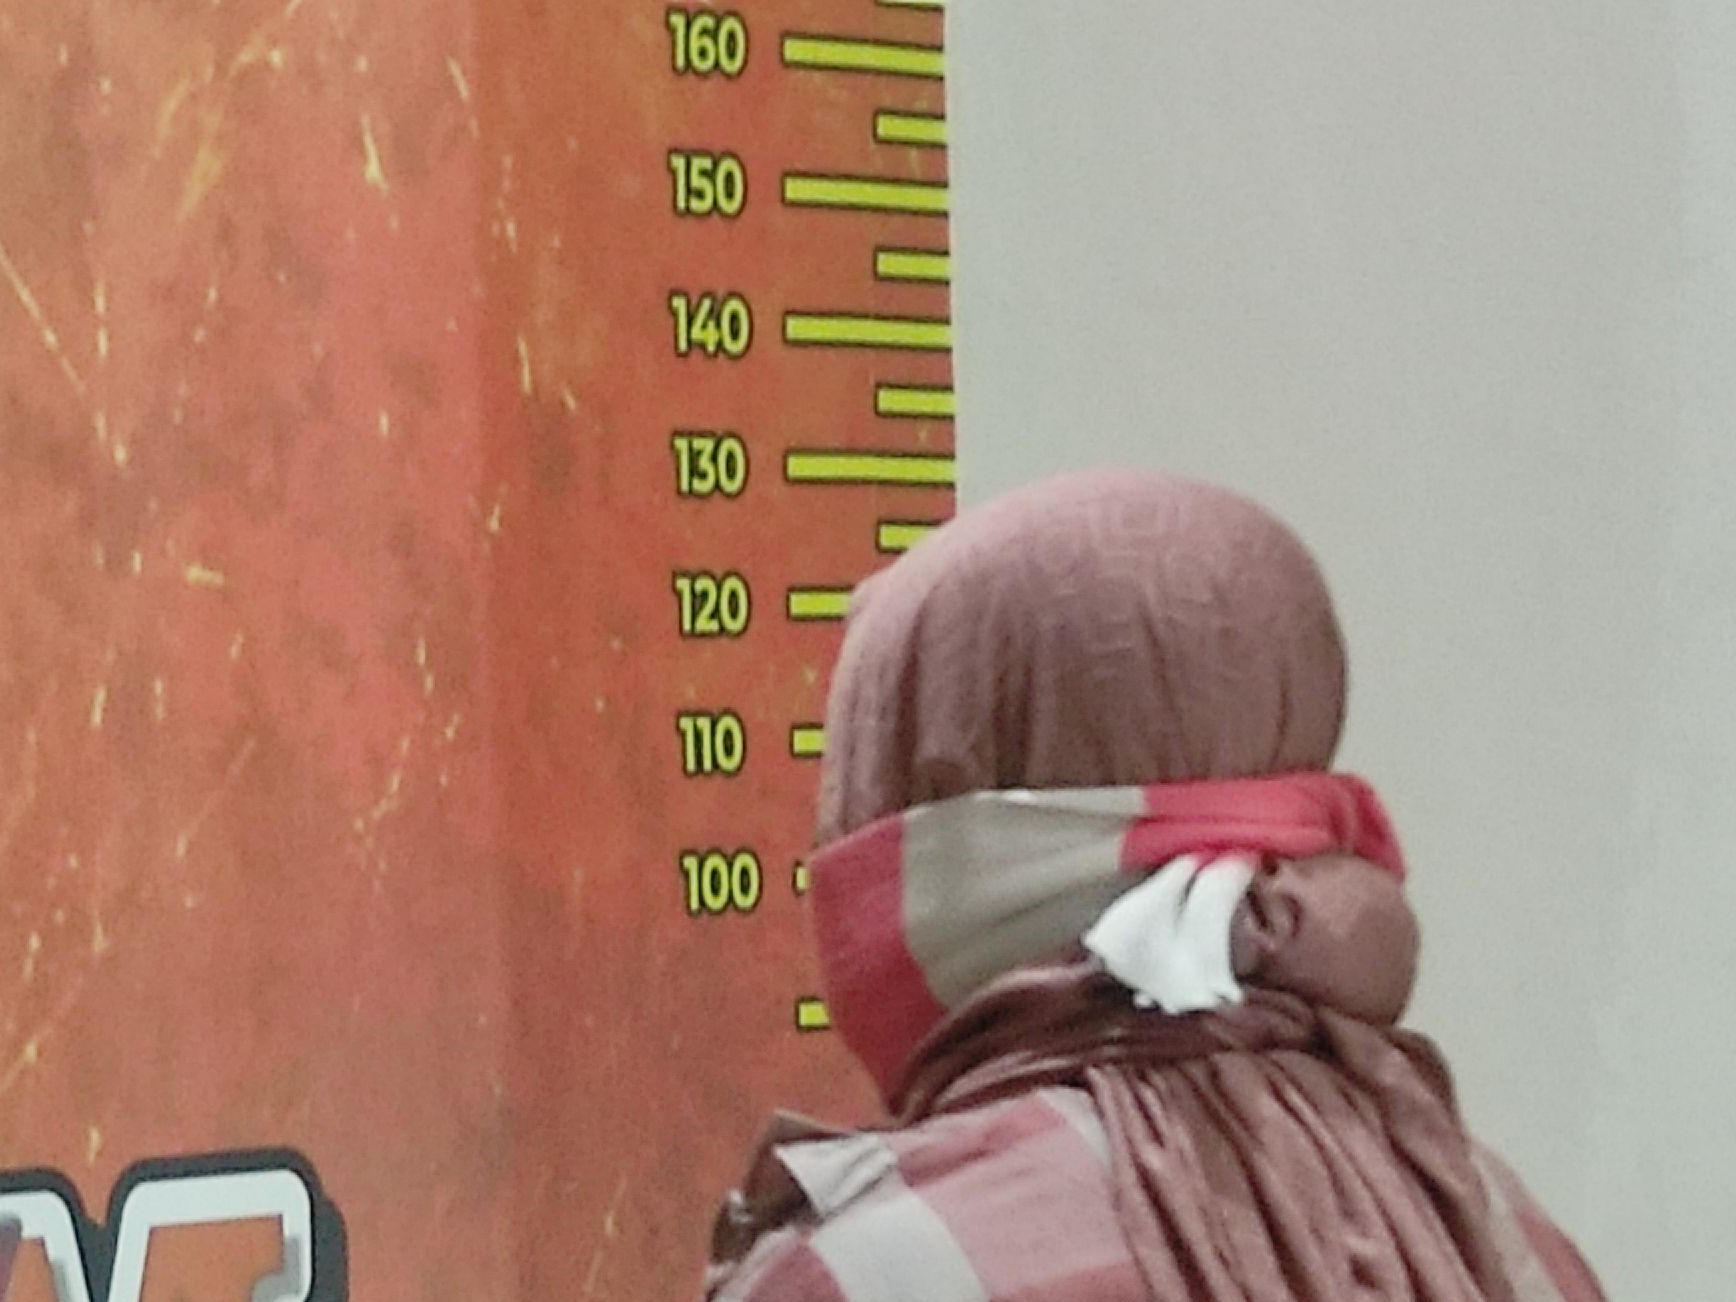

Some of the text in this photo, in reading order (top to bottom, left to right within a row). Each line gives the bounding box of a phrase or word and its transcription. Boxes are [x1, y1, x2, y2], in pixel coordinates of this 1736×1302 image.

[669, 13, 745, 74] 160
[670, 154, 742, 214] 150
[670, 295, 750, 355] 140
[673, 437, 745, 494] 130
[675, 575, 749, 632] 120
[679, 715, 744, 771] 110
[682, 852, 759, 912] 100
